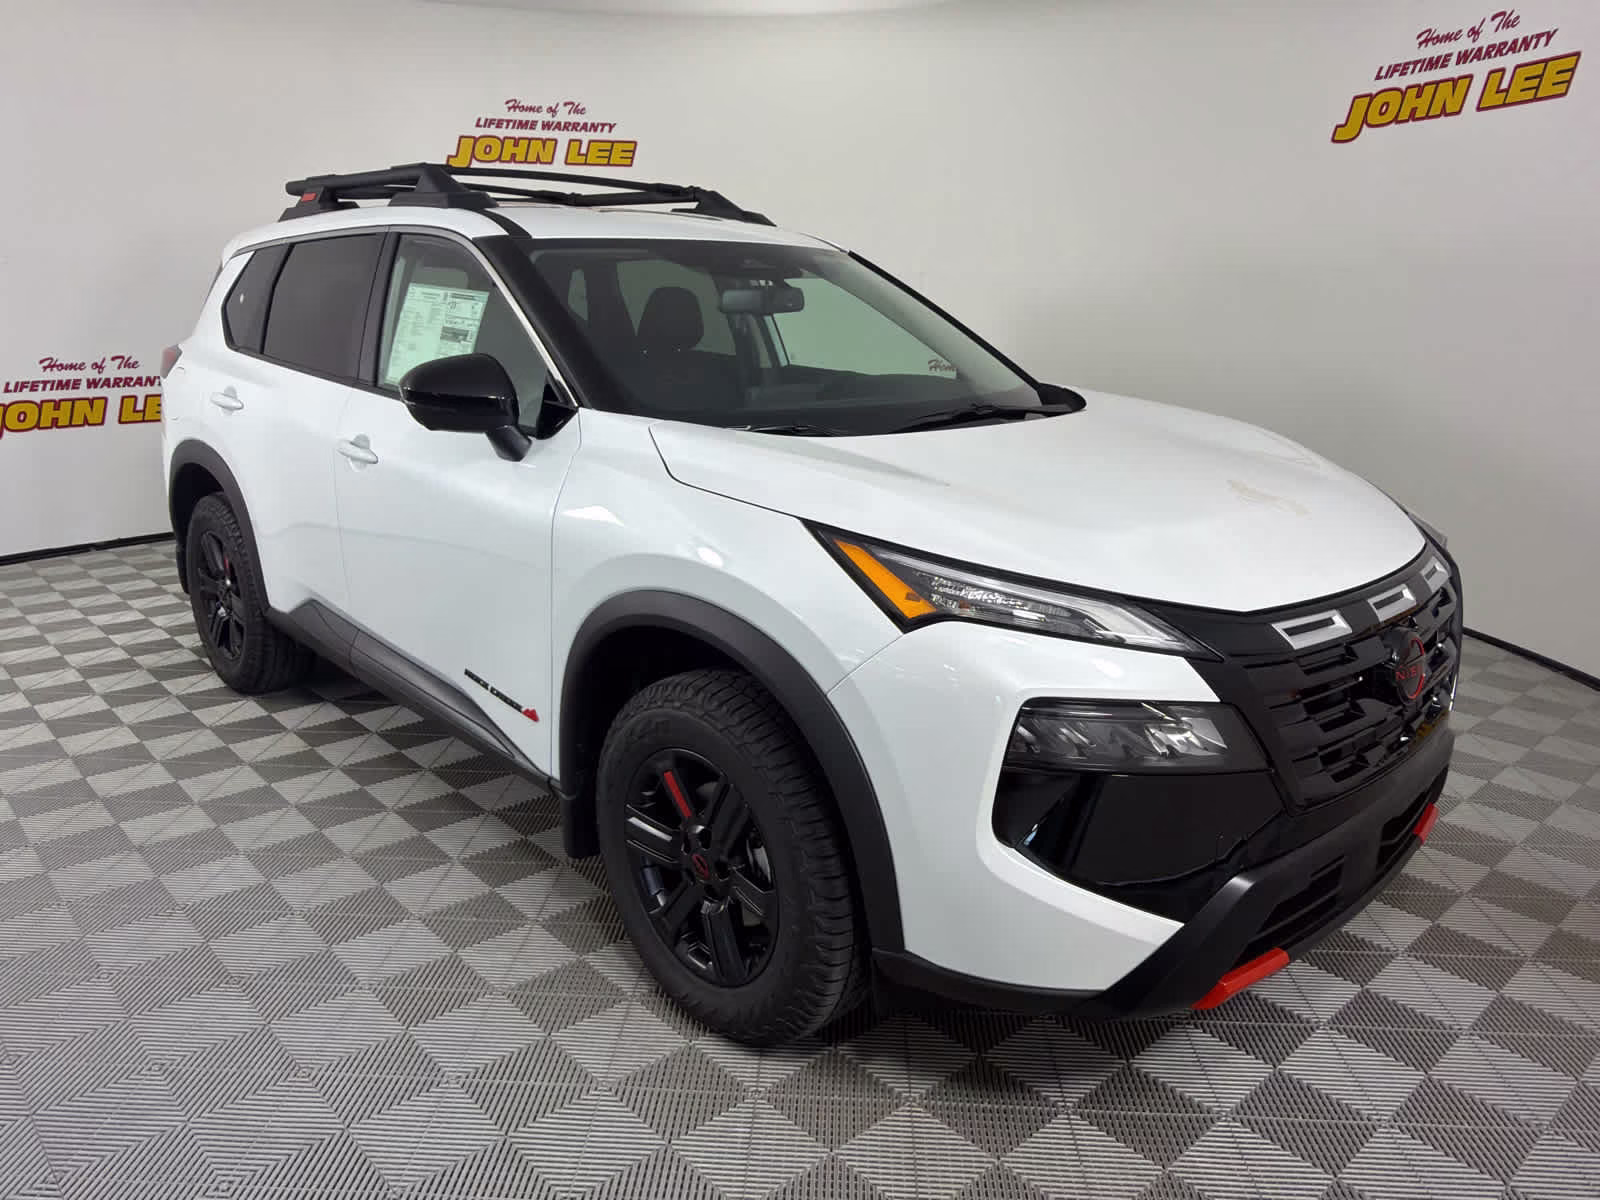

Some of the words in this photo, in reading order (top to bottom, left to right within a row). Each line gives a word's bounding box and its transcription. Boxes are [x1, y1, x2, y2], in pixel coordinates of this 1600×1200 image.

[1416, 28, 1463, 49] Home
[1466, 18, 1486, 42] of
[1491, 8, 1521, 33] The
[1374, 52, 1453, 81] LIFETIME
[1455, 28, 1559, 66] WARRANTY
[504, 99, 543, 113] Home
[546, 102, 559, 117] of
[563, 101, 586, 115] The
[1331, 74, 1474, 144] JOHN
[1476, 51, 1582, 112] LEE
[475, 117, 538, 131] LIFETIME
[540, 120, 617, 133] WARRANTY
[446, 135, 558, 168] JOHN
[564, 138, 637, 167] LEE
[38, 357, 87, 373] Home
[90, 357, 106, 374] of
[110, 355, 140, 370] The
[3, 378, 82, 394] LIFETIME
[85, 375, 161, 390] WARRAN
[0, 396, 109, 440] OHN
[118, 393, 162, 425] LE
